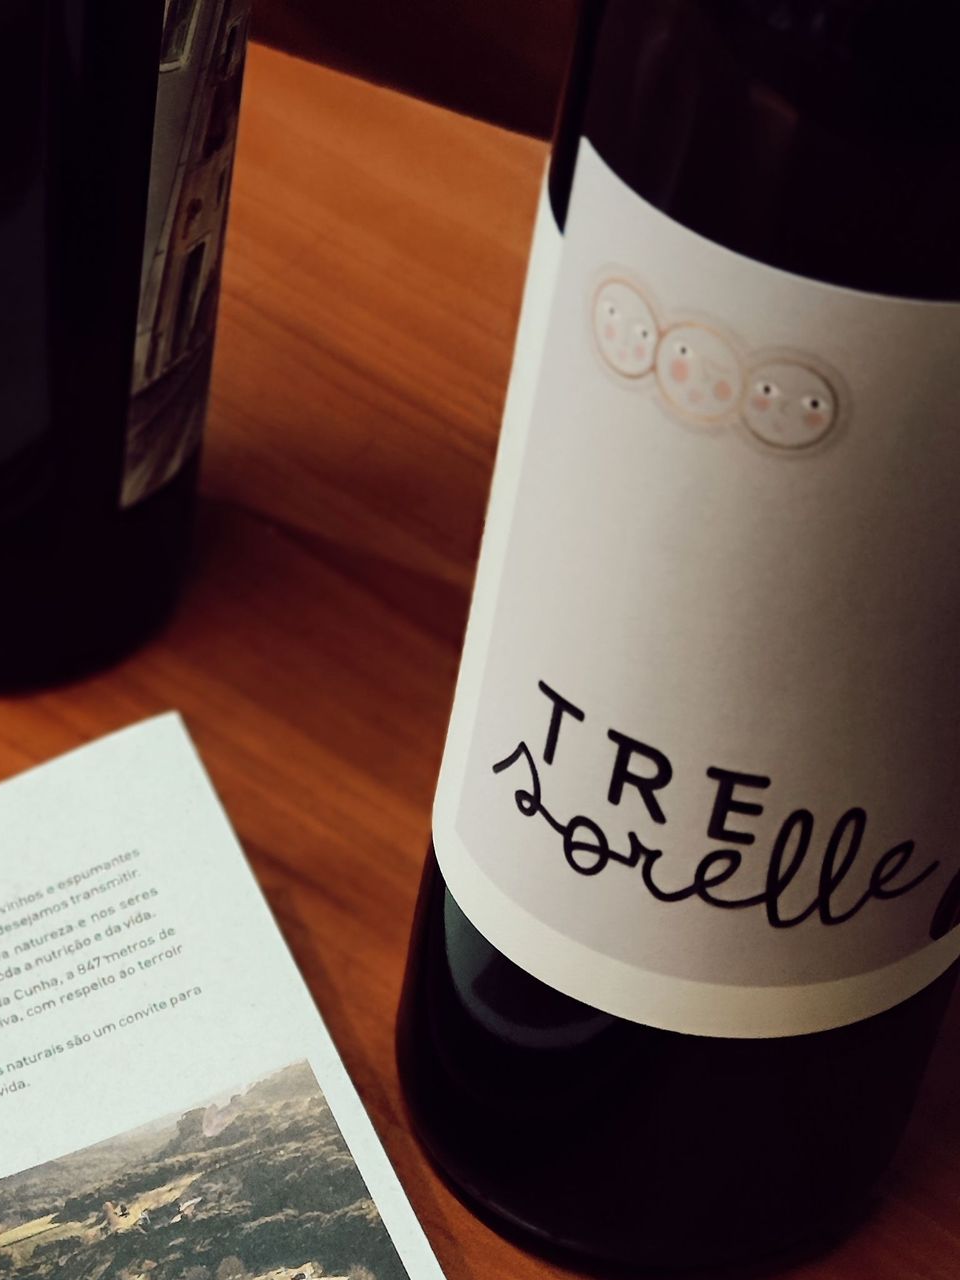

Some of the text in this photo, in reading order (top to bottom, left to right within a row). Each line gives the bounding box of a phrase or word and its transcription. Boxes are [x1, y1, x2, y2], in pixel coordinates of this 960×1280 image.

[492, 740, 939, 929] sorelle
[538, 680, 772, 846] TRE
[5, 1043, 65, 1072] naturais
[65, 1032, 91, 1049] são
[91, 1022, 117, 1038] um
[117, 1000, 168, 1027] convite
[168, 985, 202, 1008] para
